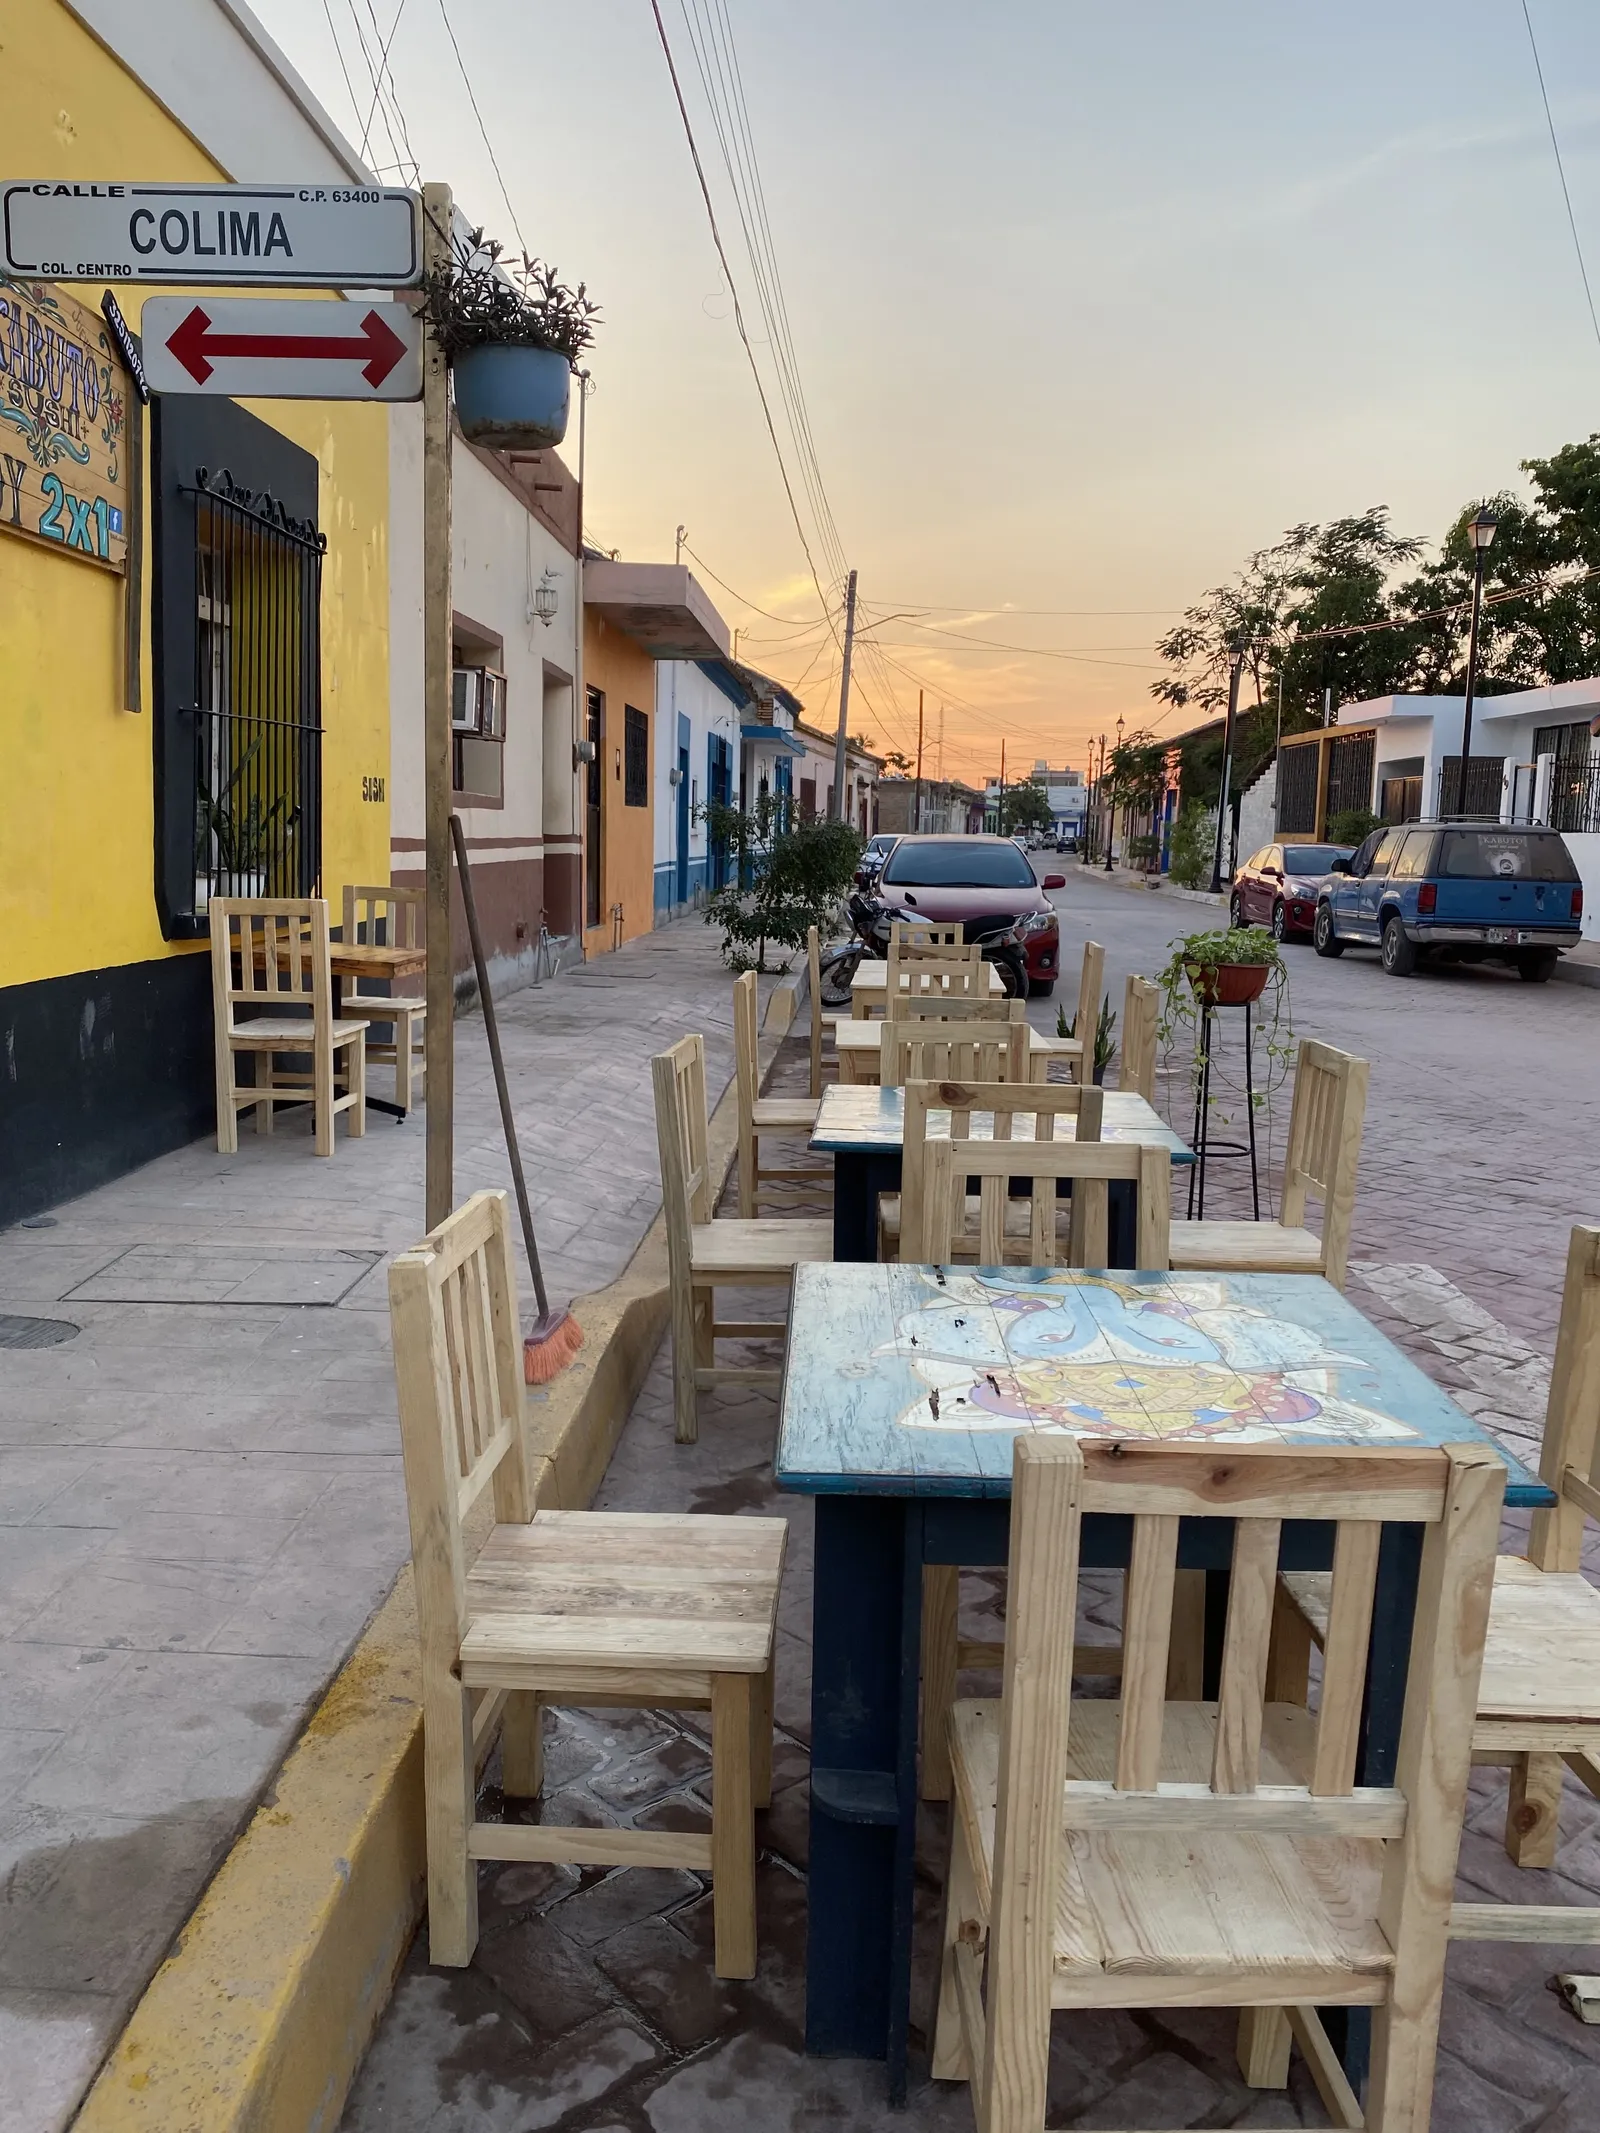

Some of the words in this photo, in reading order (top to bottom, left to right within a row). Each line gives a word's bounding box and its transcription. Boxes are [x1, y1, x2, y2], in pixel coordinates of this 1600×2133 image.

[32, 184, 126, 198] CALLE
[299, 189, 328, 203] C.P.
[332, 190, 380, 204] 63400
[129, 208, 294, 257] COLIMA
[41, 262, 73, 275] COL.
[76, 263, 132, 277] CENTRO
[8, 378, 82, 441] SUSHI
[39, 472, 109, 561] 2x1
[1483, 836, 1523, 845] KABUTO
